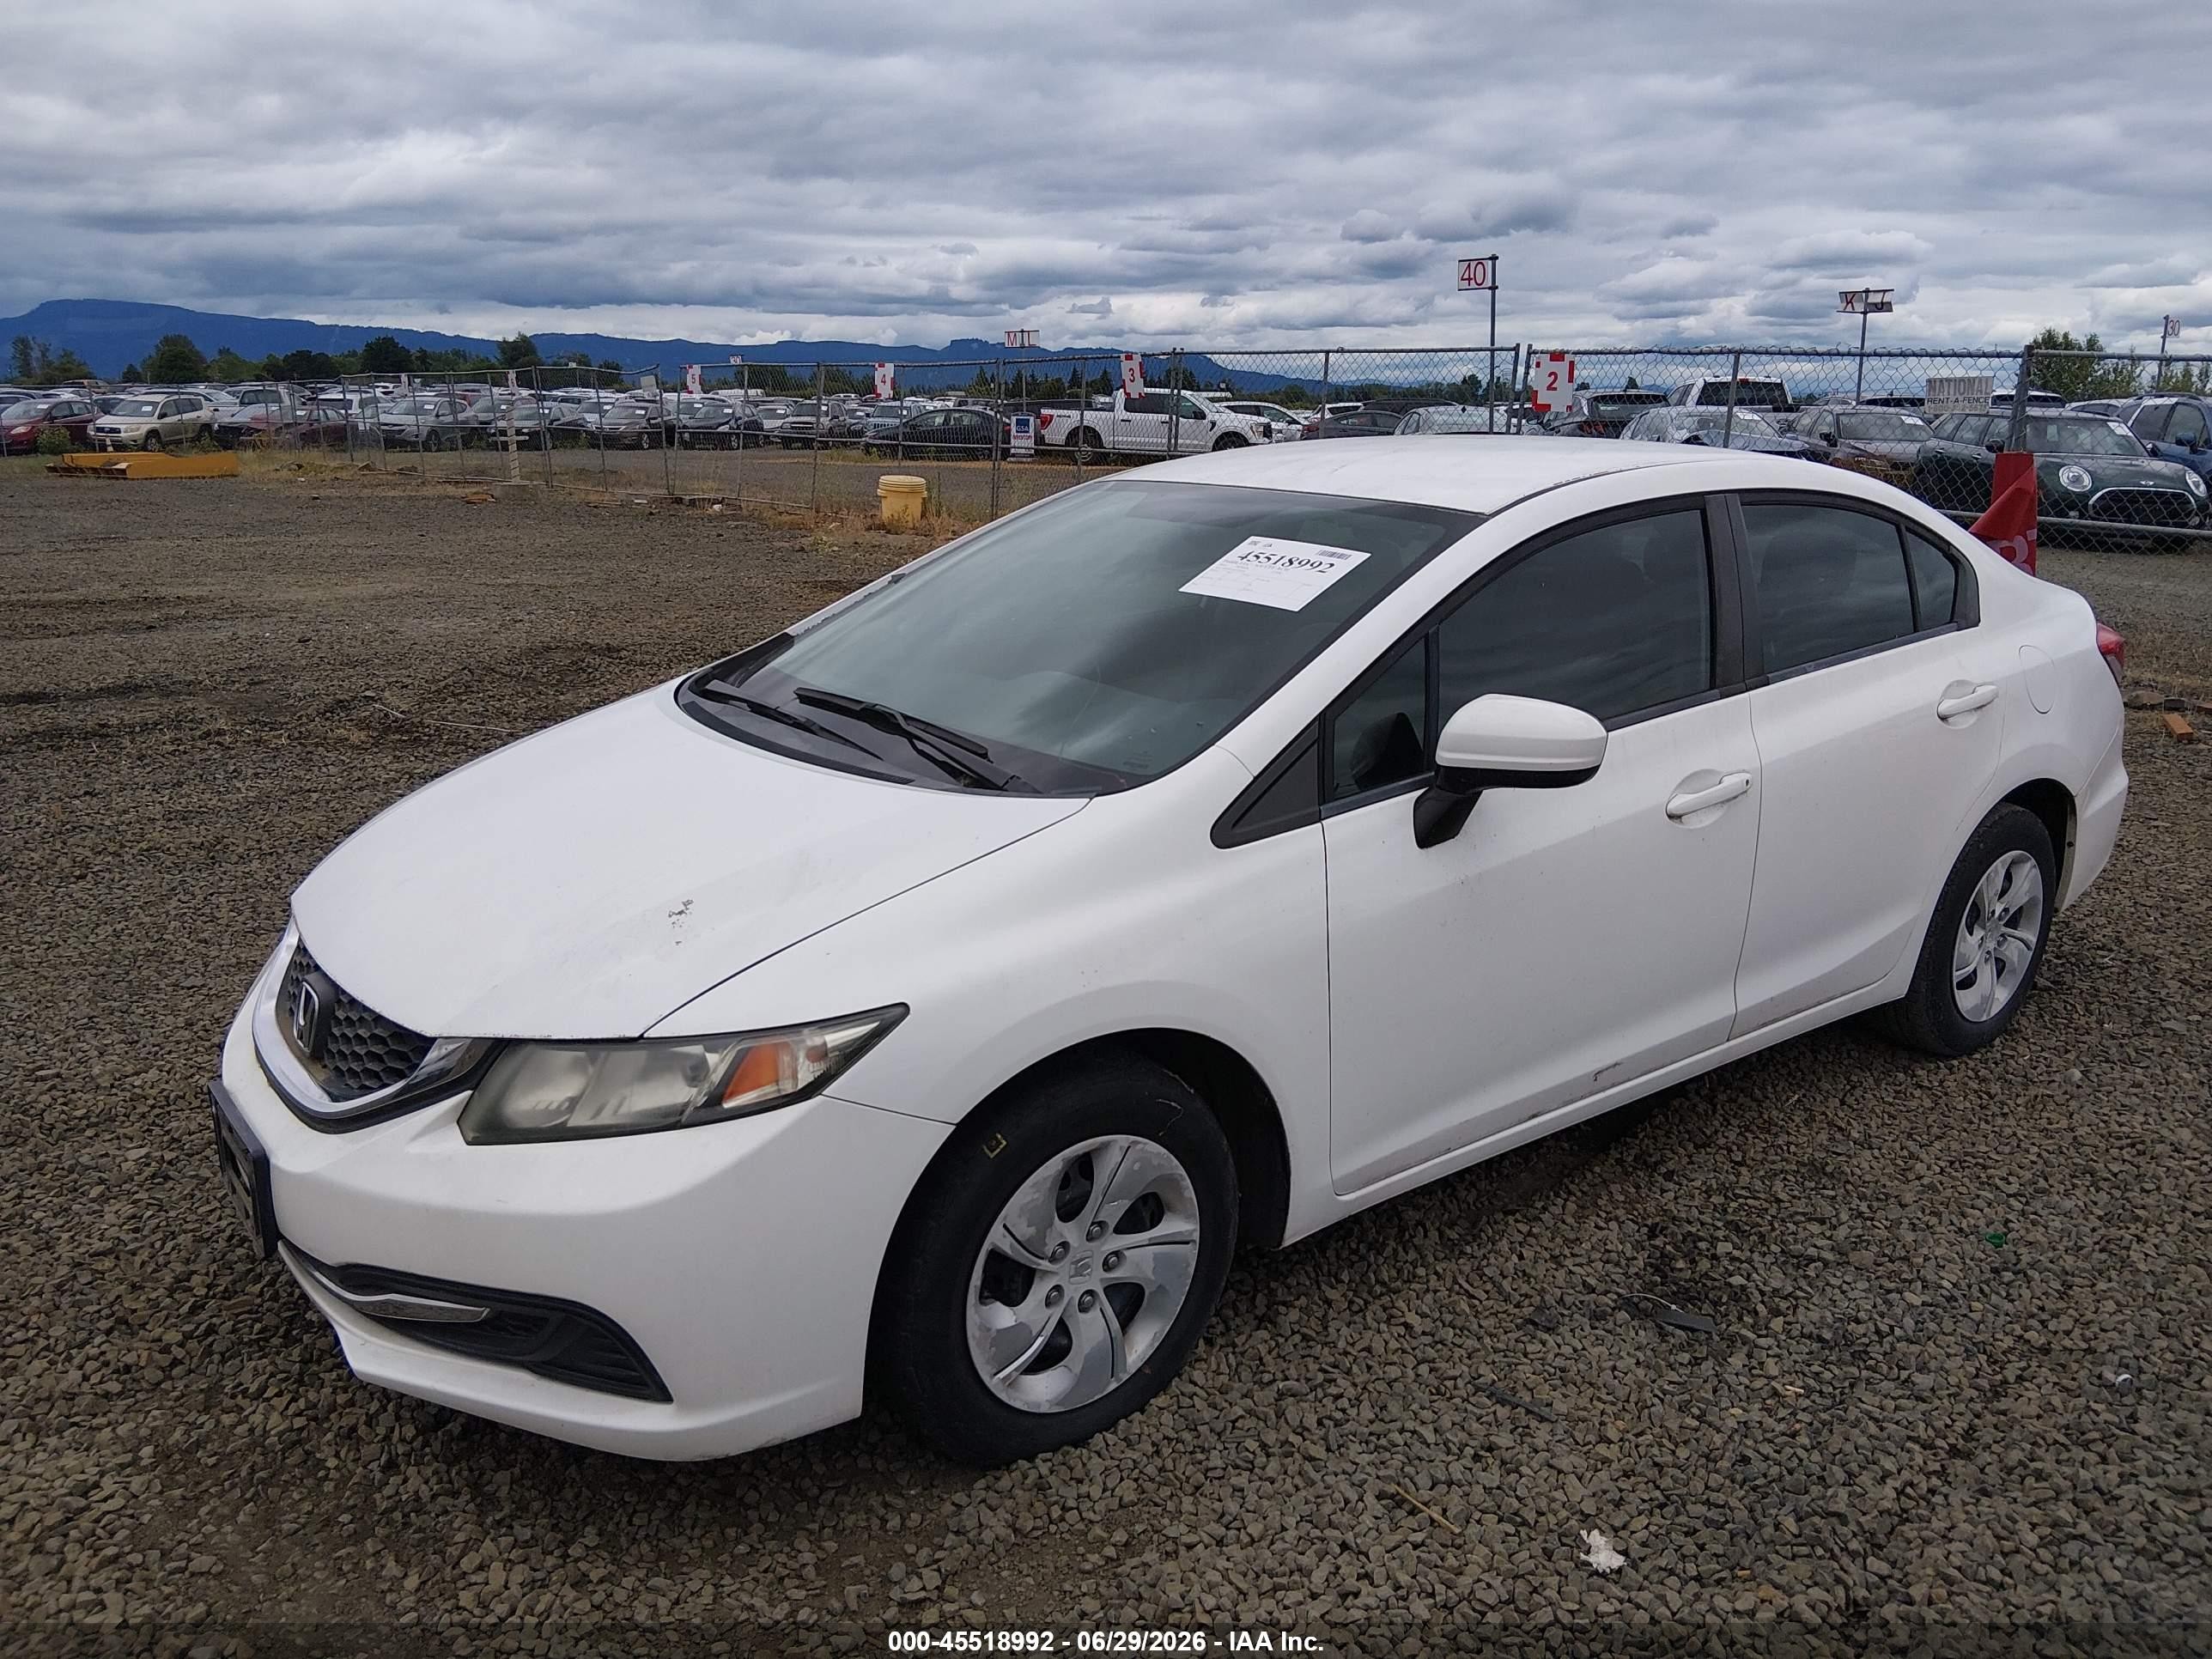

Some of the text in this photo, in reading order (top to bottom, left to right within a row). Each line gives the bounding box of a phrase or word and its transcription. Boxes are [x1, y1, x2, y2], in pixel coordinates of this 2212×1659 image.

[1461, 261, 1486, 287] 40
[1844, 291, 1886, 311] K J
[2167, 319, 2180, 336] 30
[1007, 331, 1018, 346] M
[691, 374, 696, 384] 5
[880, 374, 887, 386] 4
[1128, 368, 1135, 383] 3
[1547, 371, 1559, 392] 2
[1927, 378, 1991, 397] NATIONAL
[1927, 396, 1990, 404] RENT-A-FENCE
[1237, 550, 1335, 574] 45518992
